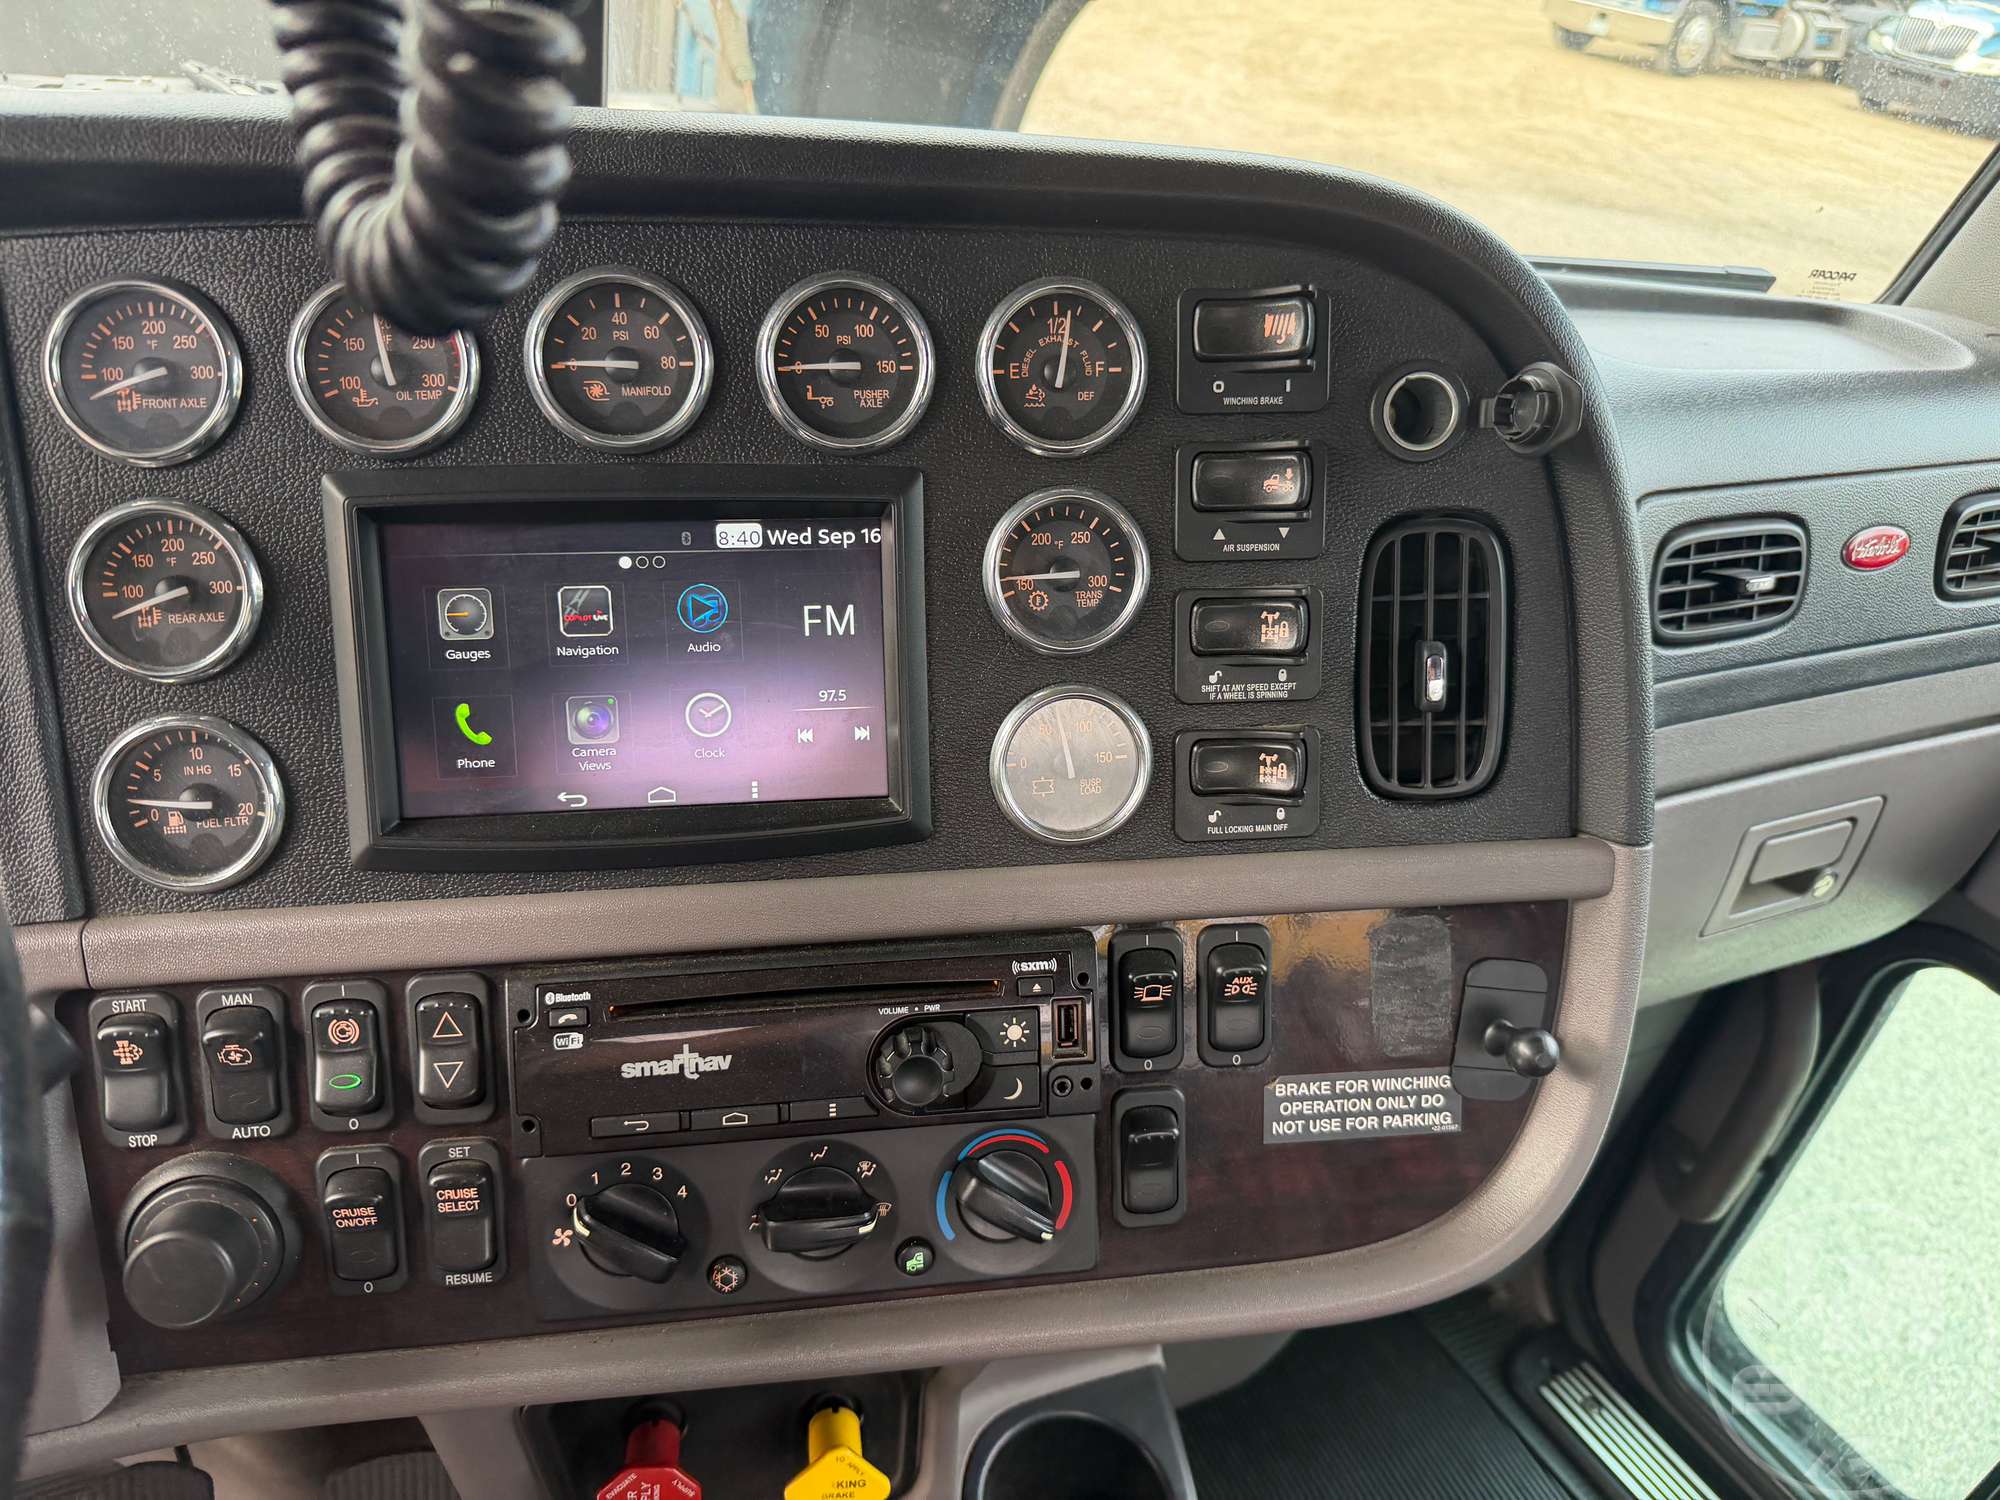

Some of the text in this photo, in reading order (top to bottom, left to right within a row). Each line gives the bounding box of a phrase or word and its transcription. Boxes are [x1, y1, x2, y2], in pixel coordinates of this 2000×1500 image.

[611, 311, 627, 325] 40
[142, 320, 166, 335] 200
[815, 324, 829, 338] 50
[854, 324, 874, 337] 100
[1047, 317, 1066, 334] 1/2
[581, 327, 596, 340] 20
[612, 331, 629, 341] PSI
[644, 326, 659, 339] 60
[112, 336, 134, 349] 150
[173, 335, 197, 349] 250
[343, 337, 365, 351] 150
[412, 336, 435, 349] 250
[836, 335, 851, 345] PSI
[1021, 335, 1092, 377] DIESEL EXHAST FLUID
[660, 356, 676, 370] 80
[876, 360, 896, 373] 150
[1096, 361, 1104, 377] F
[101, 367, 124, 381] 100
[190, 366, 214, 379] 300
[1009, 362, 1020, 379] E
[339, 376, 361, 390] 100
[422, 373, 445, 387] 300
[396, 389, 442, 401] OIL TEMP
[621, 386, 671, 396] MANIFOLD
[853, 390, 889, 399] PUSHER
[1078, 391, 1095, 401] DEF
[143, 398, 207, 409] FRONT AXLE
[860, 399, 883, 408] AXLE
[1223, 397, 1284, 406] WINCHING BRAKE
[718, 528, 881, 548] 8:40 Wed Sep 16
[1031, 533, 1051, 546] 200
[1071, 531, 1091, 544] 250
[161, 538, 185, 552] 200
[1223, 543, 1280, 553] AIR SUSPENSION
[132, 554, 154, 568] 150
[191, 551, 216, 566] 250
[208, 580, 233, 594] 300
[1016, 578, 1034, 591] 150
[1088, 575, 1107, 588] 300
[122, 584, 144, 599] 100
[1075, 590, 1103, 599] TRANS
[1076, 599, 1099, 608] TEMP
[168, 612, 225, 624] REAR AXLE
[803, 604, 855, 637] FM
[556, 645, 619, 659] Navigation
[687, 642, 721, 653] Audio
[445, 649, 492, 662] Gauges
[1201, 682, 1296, 693] SHIFT AT ANY SPEED EXCEPT
[818, 689, 847, 702] 97.5
[1222, 692, 1246, 700] WHEEL
[1256, 691, 1288, 699] SPINNING
[1075, 720, 1093, 733] 100
[189, 747, 203, 760] 10
[572, 747, 617, 758] Camera
[694, 748, 726, 759] Clock
[1095, 752, 1113, 763] 150
[228, 764, 242, 777] 15
[457, 758, 496, 770] Phone
[579, 759, 612, 772] Views
[1020, 759, 1027, 769] 0
[153, 768, 162, 782] 5
[183, 765, 212, 777] IN HG
[1080, 778, 1102, 787] SUSP
[1080, 786, 1102, 795] LOAD
[151, 809, 159, 822] 0
[237, 802, 254, 816] 20
[196, 817, 249, 829] FUEL FLTR
[1208, 823, 1289, 834] FULL LOCKING MAIN DIFF
[222, 993, 253, 1006] MAN
[555, 992, 591, 1002] Bluetooth
[112, 1000, 147, 1013] START
[878, 1004, 940, 1016] VOLUME PWR
[620, 1044, 733, 1080] smartnav
[1275, 1075, 1452, 1097] BRAKE FOR WINCHING
[1279, 1094, 1445, 1116] OPERATION ONLY DO
[1272, 1120, 1305, 1136] NOT
[1309, 1118, 1341, 1133] USE
[1345, 1116, 1378, 1130] FOR
[1382, 1111, 1452, 1128] PARKING
[232, 1125, 271, 1139] AUTO
[128, 1135, 158, 1148] STOP
[448, 1146, 471, 1158] SET
[566, 1163, 688, 1206] 0 1 2 3 4
[436, 1188, 478, 1200] CRUISE
[332, 1207, 376, 1218] CRUISE
[437, 1200, 480, 1213] SELECT
[335, 1217, 378, 1228] ON/OFF
[446, 1272, 492, 1286] RESUME
